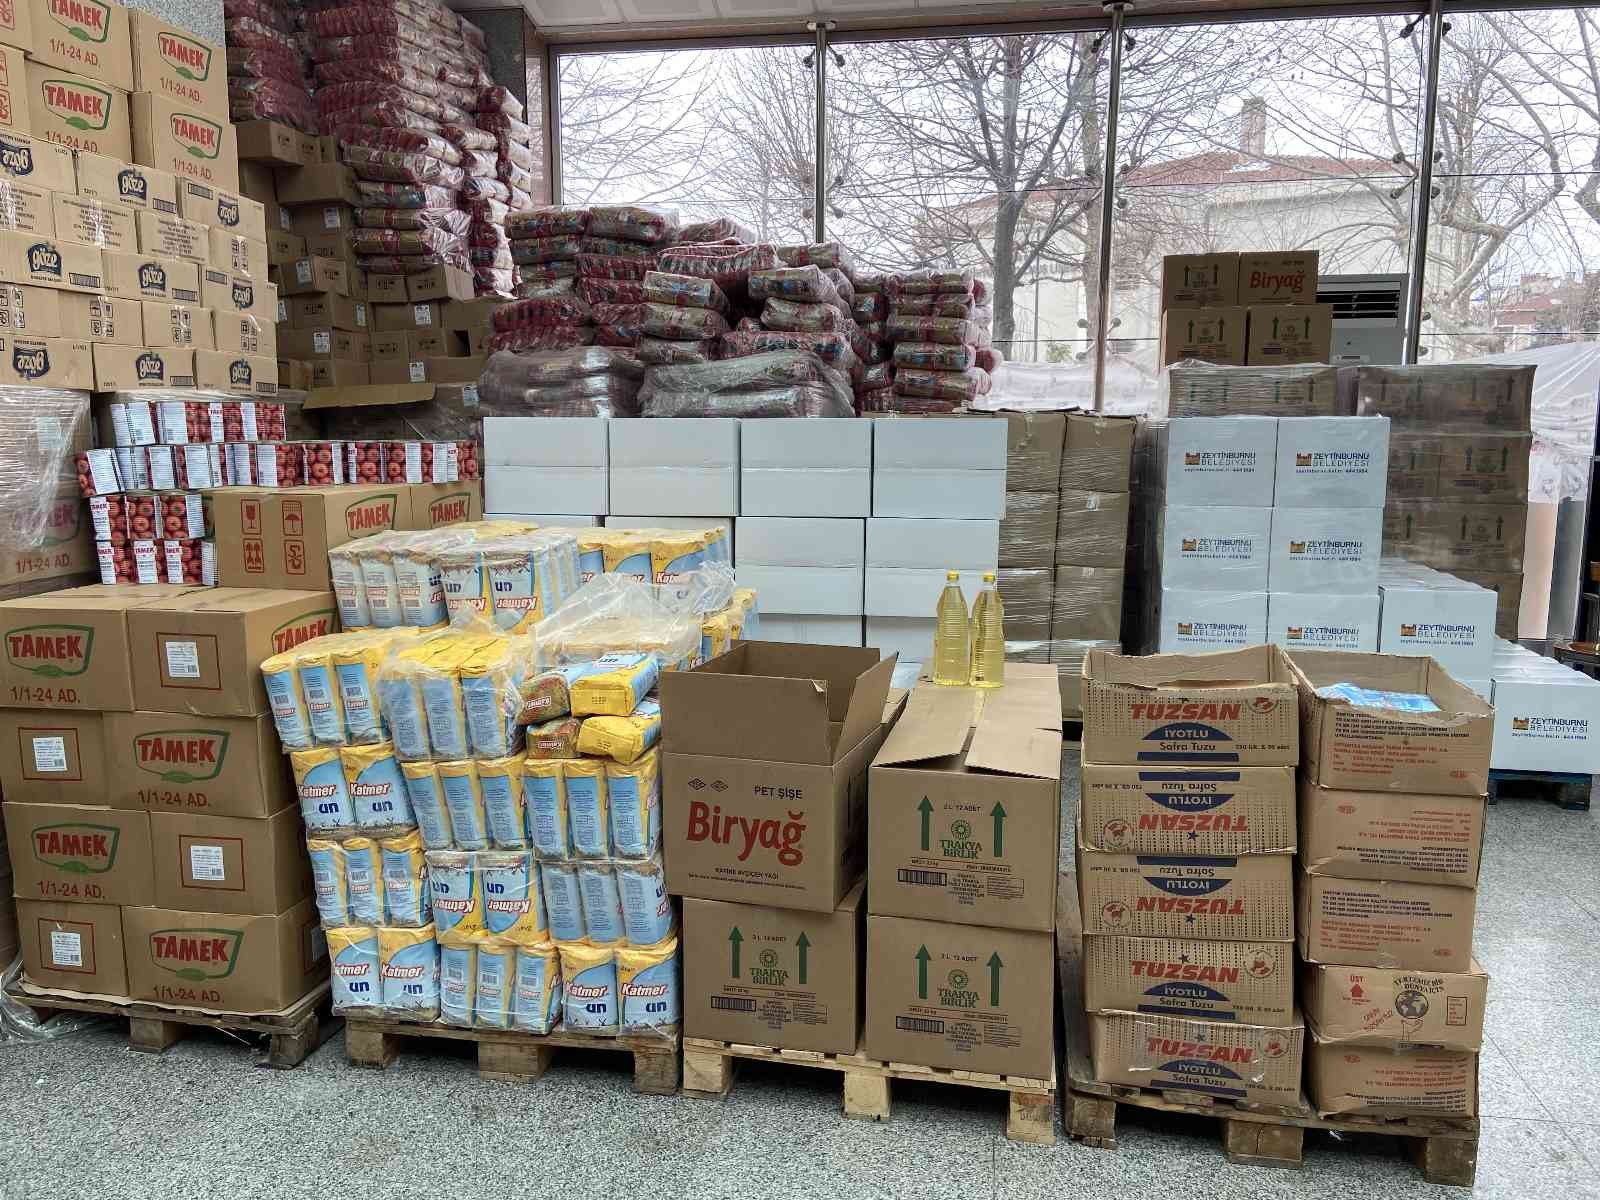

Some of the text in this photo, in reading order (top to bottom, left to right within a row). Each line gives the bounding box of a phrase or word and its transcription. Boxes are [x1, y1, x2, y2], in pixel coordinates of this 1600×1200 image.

[51, 0, 103, 30] TAMEK
[160, 37, 205, 70] TAMEK
[45, 85, 104, 118] TAMEK
[174, 118, 215, 148] TAMEK
[122, 174, 144, 193] göze
[32, 248, 58, 270] göze
[1249, 270, 1305, 296] Biryağ
[140, 356, 160, 377] göze
[348, 504, 390, 530] TAMEK
[430, 500, 466, 524] TAMEK
[497, 596, 537, 610] Katmer
[274, 620, 328, 651] TAMEK
[8, 635, 83, 660] TAMEK
[10, 687, 80, 704] 1/1-24 AD.
[1131, 704, 1242, 721] TUZSAN
[138, 739, 216, 764] TAMEK
[1192, 742, 1216, 752] Tuzu
[350, 782, 390, 796] Katmer
[754, 786, 803, 801] PET ŞİŞE
[1162, 783, 1185, 792] Tuzu
[138, 790, 182, 807] 1/1-24
[372, 800, 393, 812] un
[318, 802, 339, 814] un
[1138, 814, 1248, 832] TUZSAN
[686, 800, 806, 866] Biryağ
[36, 832, 108, 857] TAMEK
[940, 840, 982, 852] TRAKYA
[37, 881, 105, 898] 1/1-24 AD.
[487, 882, 504, 894] un
[488, 898, 530, 914] Katmer
[1136, 896, 1248, 914] TUZSAN
[152, 936, 230, 962] TAMEK
[380, 962, 424, 978] Katmer
[750, 967, 790, 978] TRAKYA
[1131, 960, 1240, 983] TUZSAN
[153, 985, 196, 1002] 1/1-24
[350, 982, 370, 993] un
[567, 982, 609, 998] Katmer
[622, 982, 668, 998] Katmer
[937, 988, 980, 1000] TRAKYA
[586, 1003, 607, 1013] un
[646, 1001, 667, 1013] un
[1190, 1000, 1214, 1009] Tuzu
[1148, 1037, 1256, 1063] TUZSAN
[1202, 1076, 1226, 1087] Tuzu
